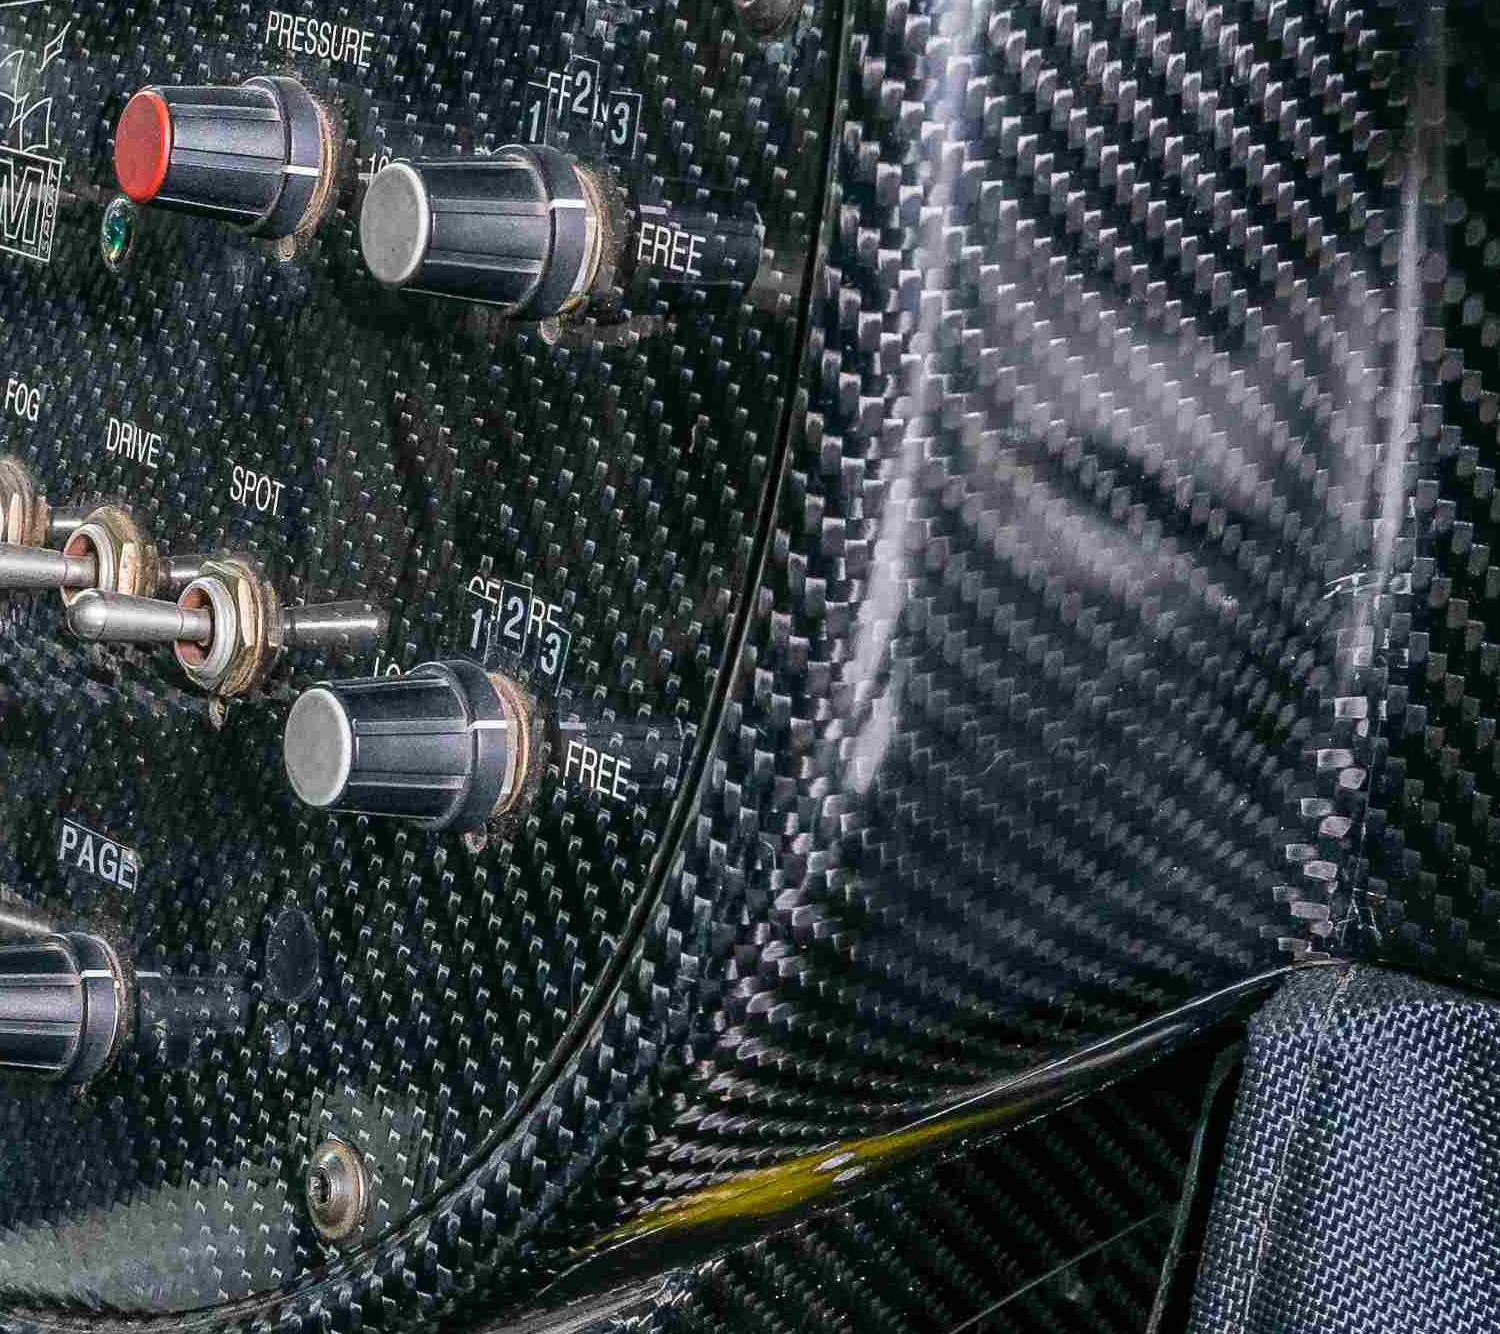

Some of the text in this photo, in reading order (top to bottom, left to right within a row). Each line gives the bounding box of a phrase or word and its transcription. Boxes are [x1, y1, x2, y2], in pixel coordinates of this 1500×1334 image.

[265, 10, 376, 68] PRESSURE
[571, 70, 593, 115] 2
[528, 100, 543, 143] 1
[610, 101, 631, 146] 3
[636, 220, 707, 277] FREE
[4, 377, 41, 422] FOG
[105, 416, 162, 469] DRIVE
[230, 465, 285, 516] SPOT
[503, 595, 525, 641] 2
[540, 632, 562, 676] 3
[562, 739, 632, 802] FREE
[56, 824, 137, 892] PAGE
